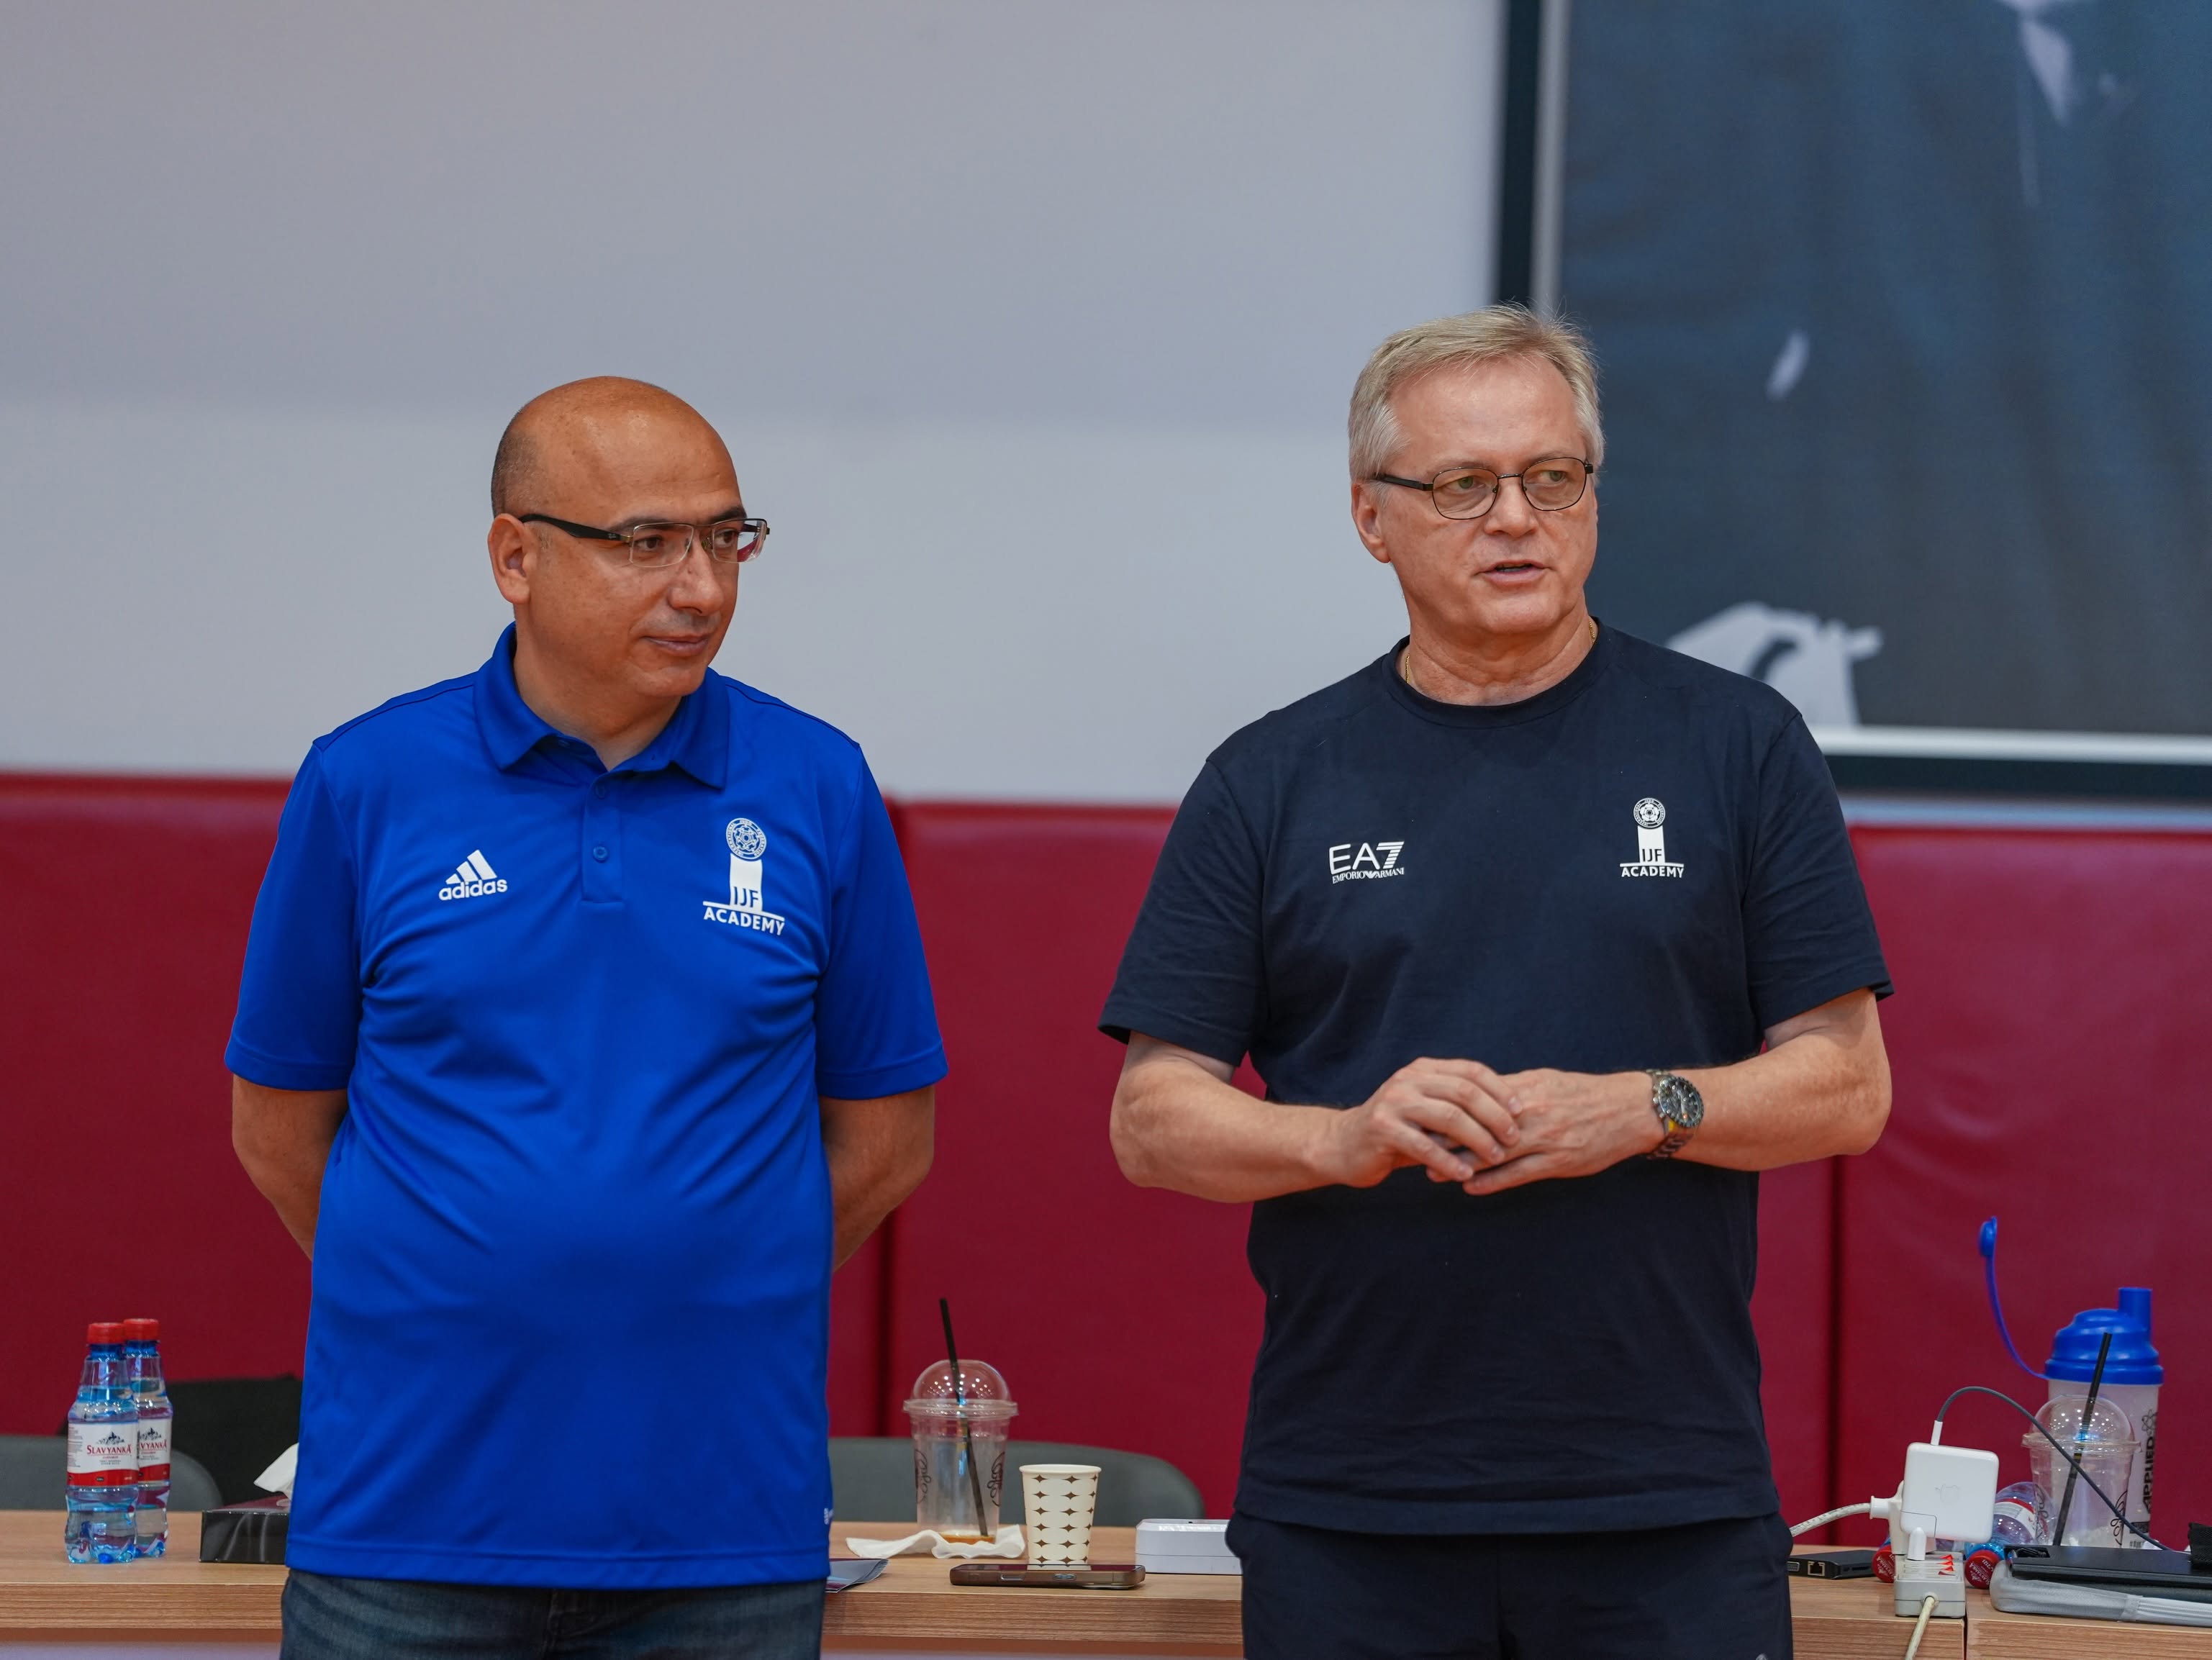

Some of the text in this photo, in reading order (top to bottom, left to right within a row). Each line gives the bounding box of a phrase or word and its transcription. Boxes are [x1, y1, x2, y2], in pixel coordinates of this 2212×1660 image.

[1328, 841, 1405, 875] EA7
[1642, 848, 1662, 862] IJF
[1332, 867, 1405, 884] EMPORIO ARMANI
[1621, 866, 1685, 878] ACADEMY
[438, 879, 508, 901] adidas
[733, 886, 758, 908] IJF
[703, 907, 785, 935] ACADEMY
[86, 1443, 132, 1454] SLAVYANKA
[139, 1439, 168, 1450] VYANKA
[2142, 1436, 2156, 1514] APPLIED
